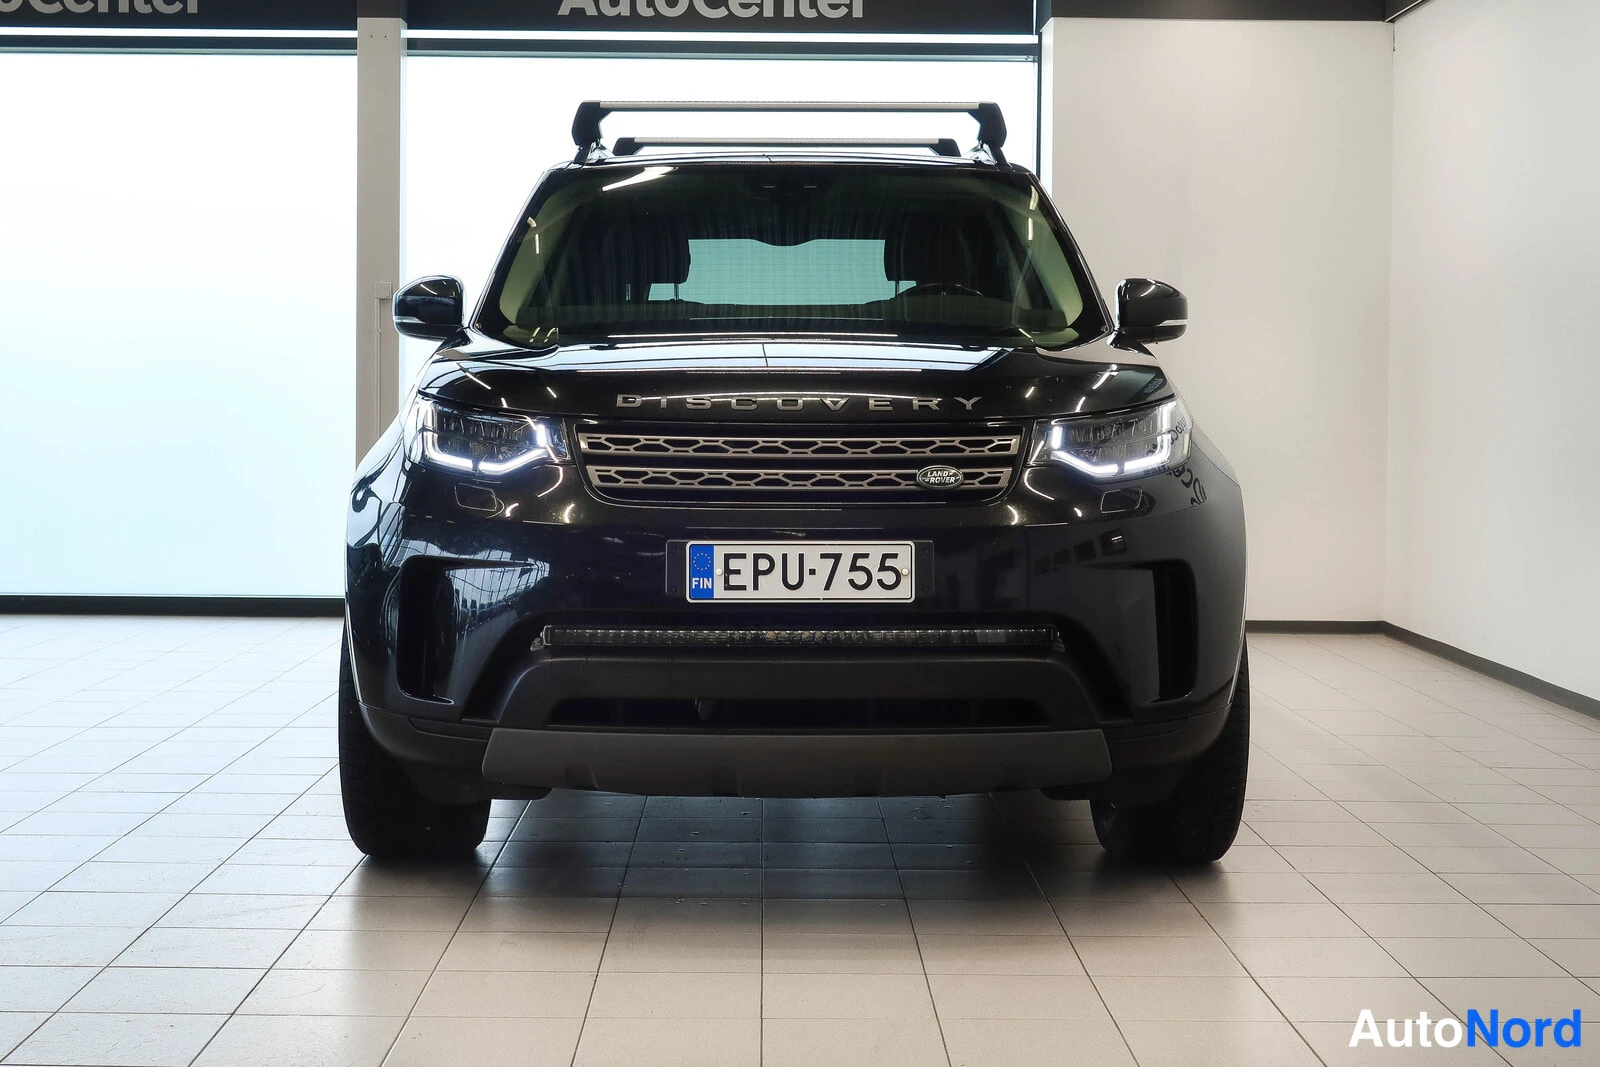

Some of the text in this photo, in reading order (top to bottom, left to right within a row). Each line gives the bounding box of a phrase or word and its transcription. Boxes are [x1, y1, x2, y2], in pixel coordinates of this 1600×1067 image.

[616, 393, 982, 411] DISCOVERY
[929, 476, 956, 484] ROVER
[692, 577, 712, 589] FIN
